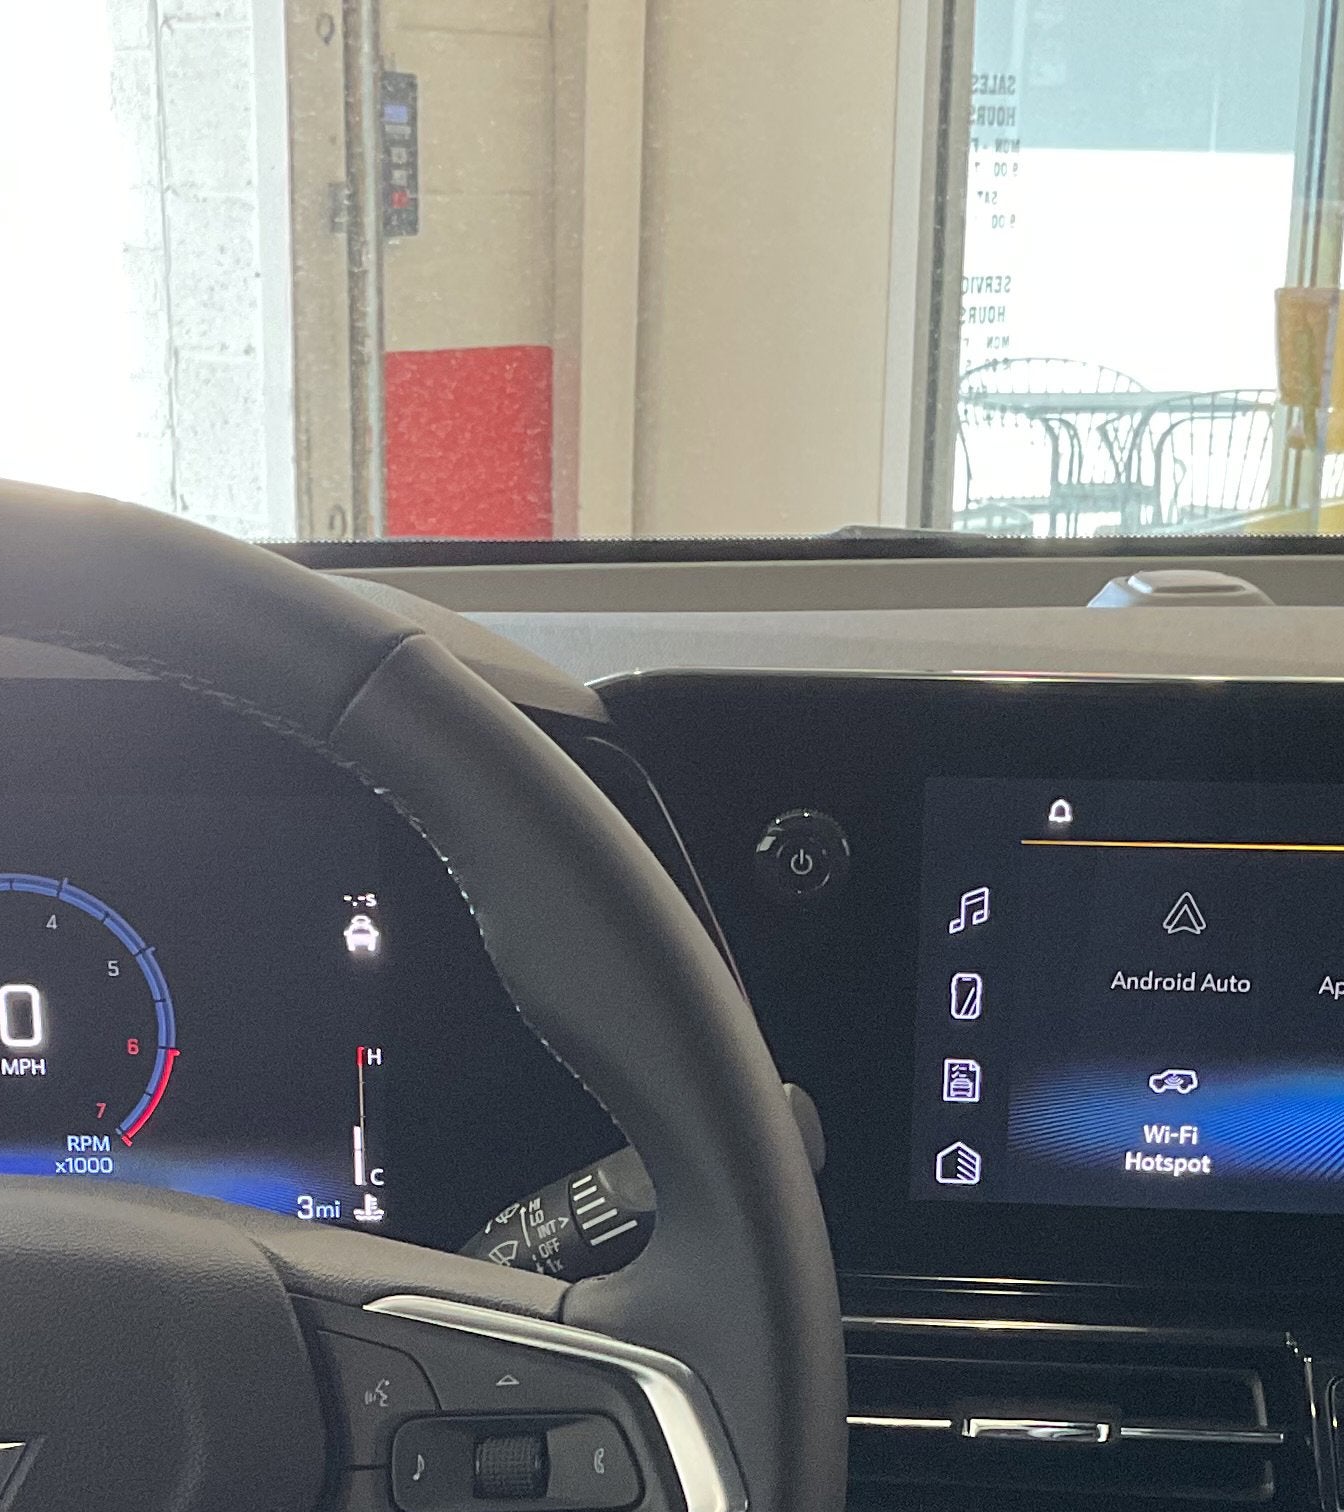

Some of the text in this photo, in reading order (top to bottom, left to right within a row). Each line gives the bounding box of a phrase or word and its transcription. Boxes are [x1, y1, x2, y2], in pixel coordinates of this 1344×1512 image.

[46, 914, 58, 931] 4
[107, 961, 119, 976] 5
[1110, 971, 1252, 994] Android Auto
[127, 1039, 140, 1055] 6
[366, 1048, 382, 1066] H
[1, 1058, 46, 1077] MPH
[96, 1103, 106, 1119] 7
[67, 1135, 112, 1153] RPM
[1143, 1123, 1199, 1147] Wi-Fi
[55, 1156, 114, 1174] x1000
[1124, 1150, 1212, 1176] Hotspot
[369, 1168, 385, 1187] C
[528, 1197, 541, 1213] HI
[529, 1209, 545, 1228] LO
[537, 1219, 557, 1239] INT
[538, 1237, 561, 1259] OFF
